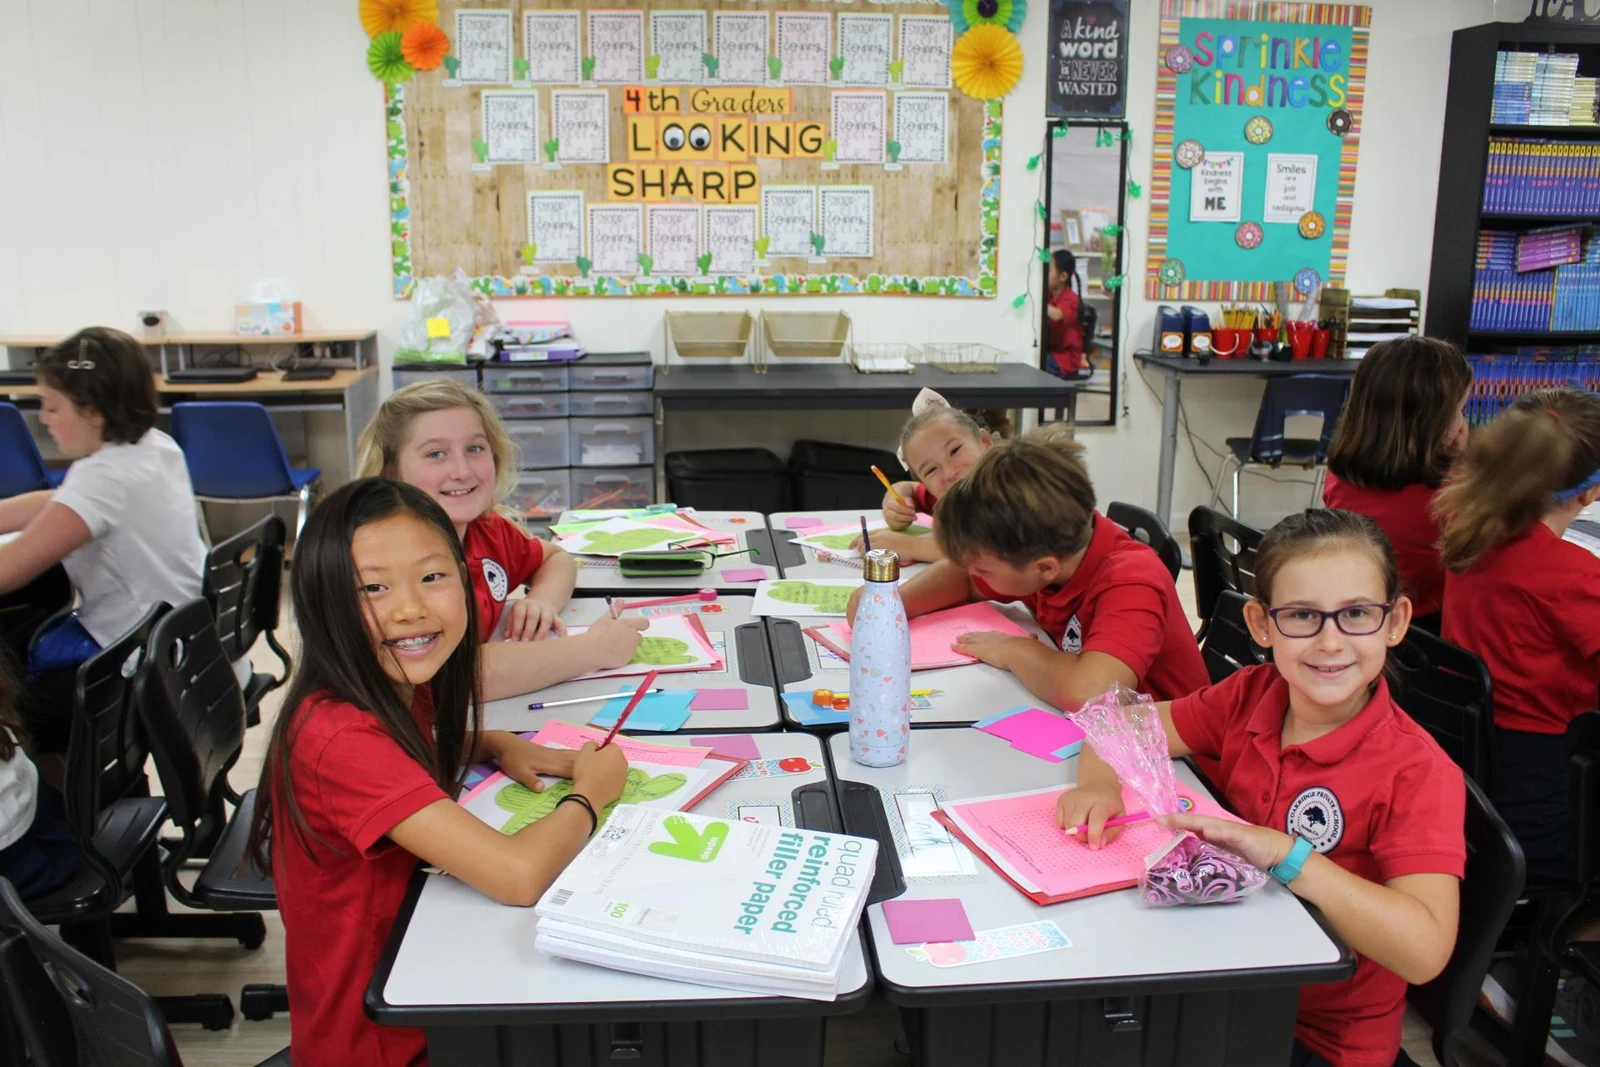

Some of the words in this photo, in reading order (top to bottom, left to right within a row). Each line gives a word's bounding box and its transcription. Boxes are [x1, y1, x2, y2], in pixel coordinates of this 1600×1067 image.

[1074, 16, 1120, 39] kind
[1059, 40, 1119, 59] word
[1193, 31, 1342, 72] Sprinkle
[1072, 60, 1118, 81] NEVER
[626, 88, 680, 112] 4th
[691, 88, 786, 113] Graders
[1058, 81, 1118, 96] WASTED
[1189, 69, 1346, 108] Kindness
[632, 122, 823, 154] LOOKING
[1276, 163, 1307, 174] Smiles
[612, 167, 757, 200] SHARP
[1204, 196, 1226, 211] ME
[765, 832, 804, 880] filler
[836, 840, 863, 889] quad
[770, 835, 831, 934] reinforced
[610, 902, 629, 918] 100
[734, 881, 777, 935] paper
